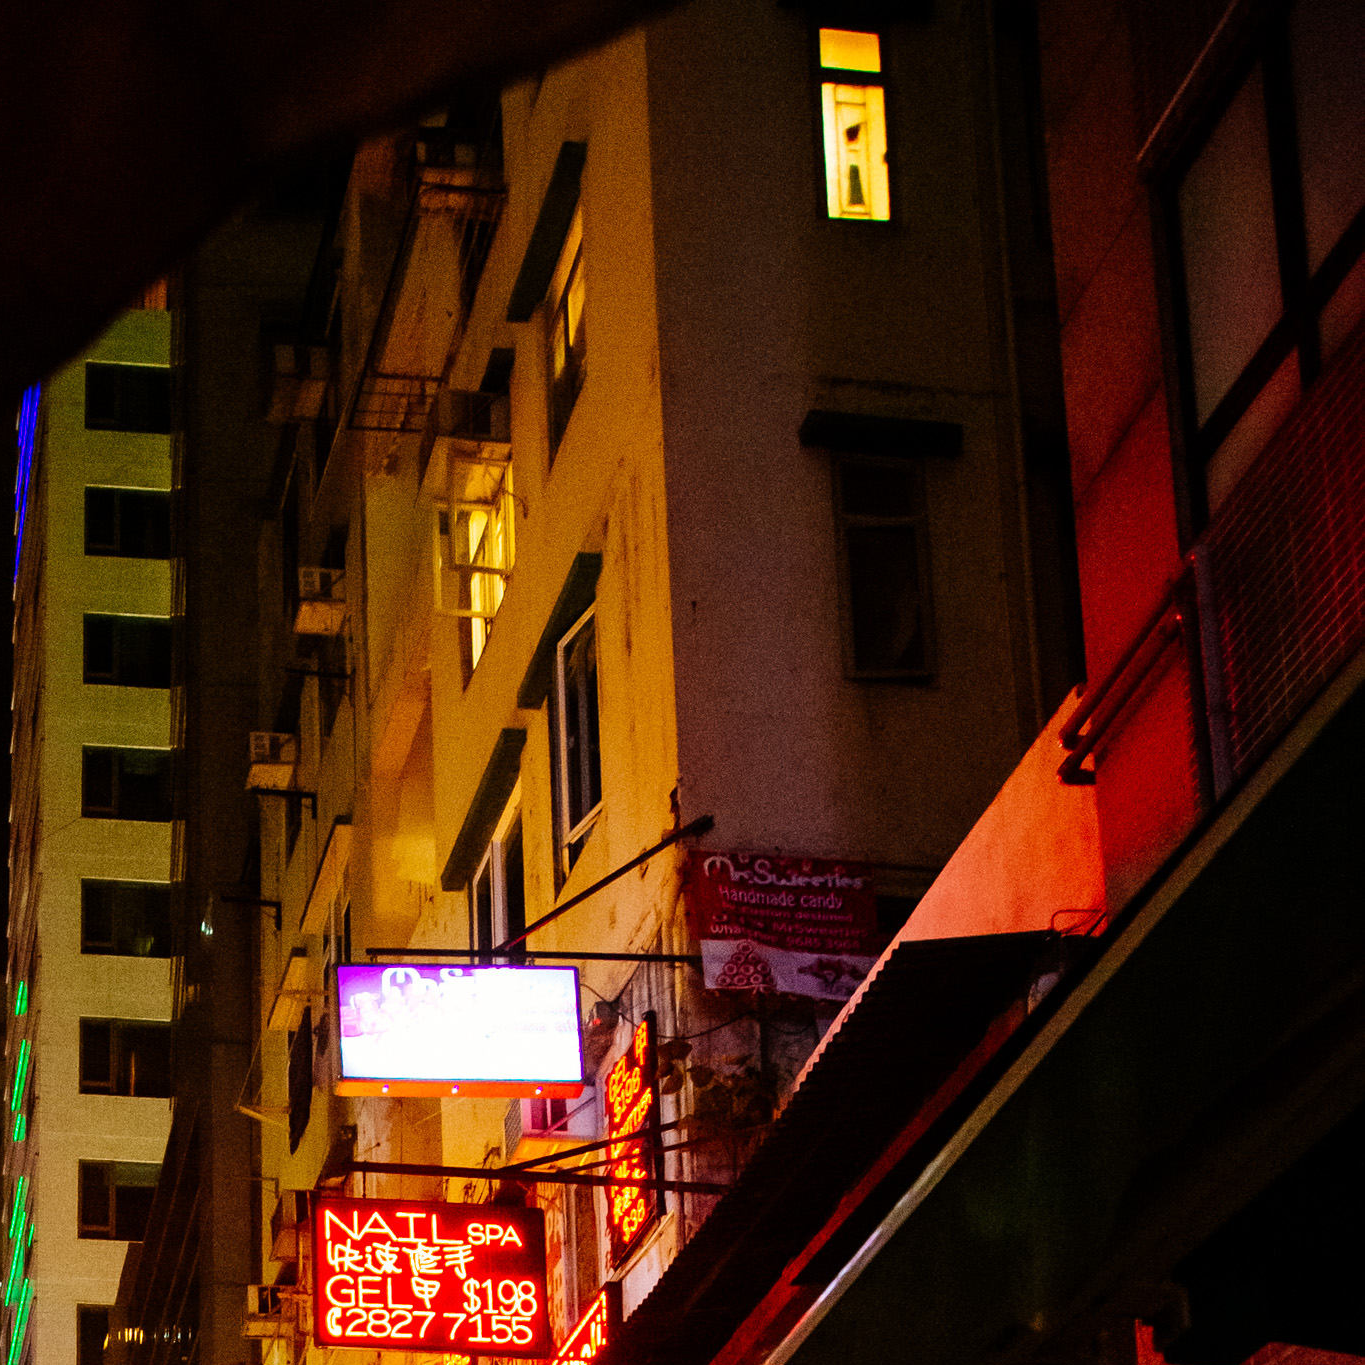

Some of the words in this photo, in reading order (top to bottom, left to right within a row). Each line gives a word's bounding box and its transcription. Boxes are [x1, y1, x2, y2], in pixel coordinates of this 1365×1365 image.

[718, 882, 796, 908] Handmade
[799, 892, 844, 910] candy
[324, 1209, 464, 1244] NAIL
[467, 1222, 523, 1248] SPA
[327, 1238, 475, 1280] 快速修手
[462, 1277, 538, 1317] $198
[344, 1308, 436, 1339] 2827
[443, 1312, 534, 1345] 7155
